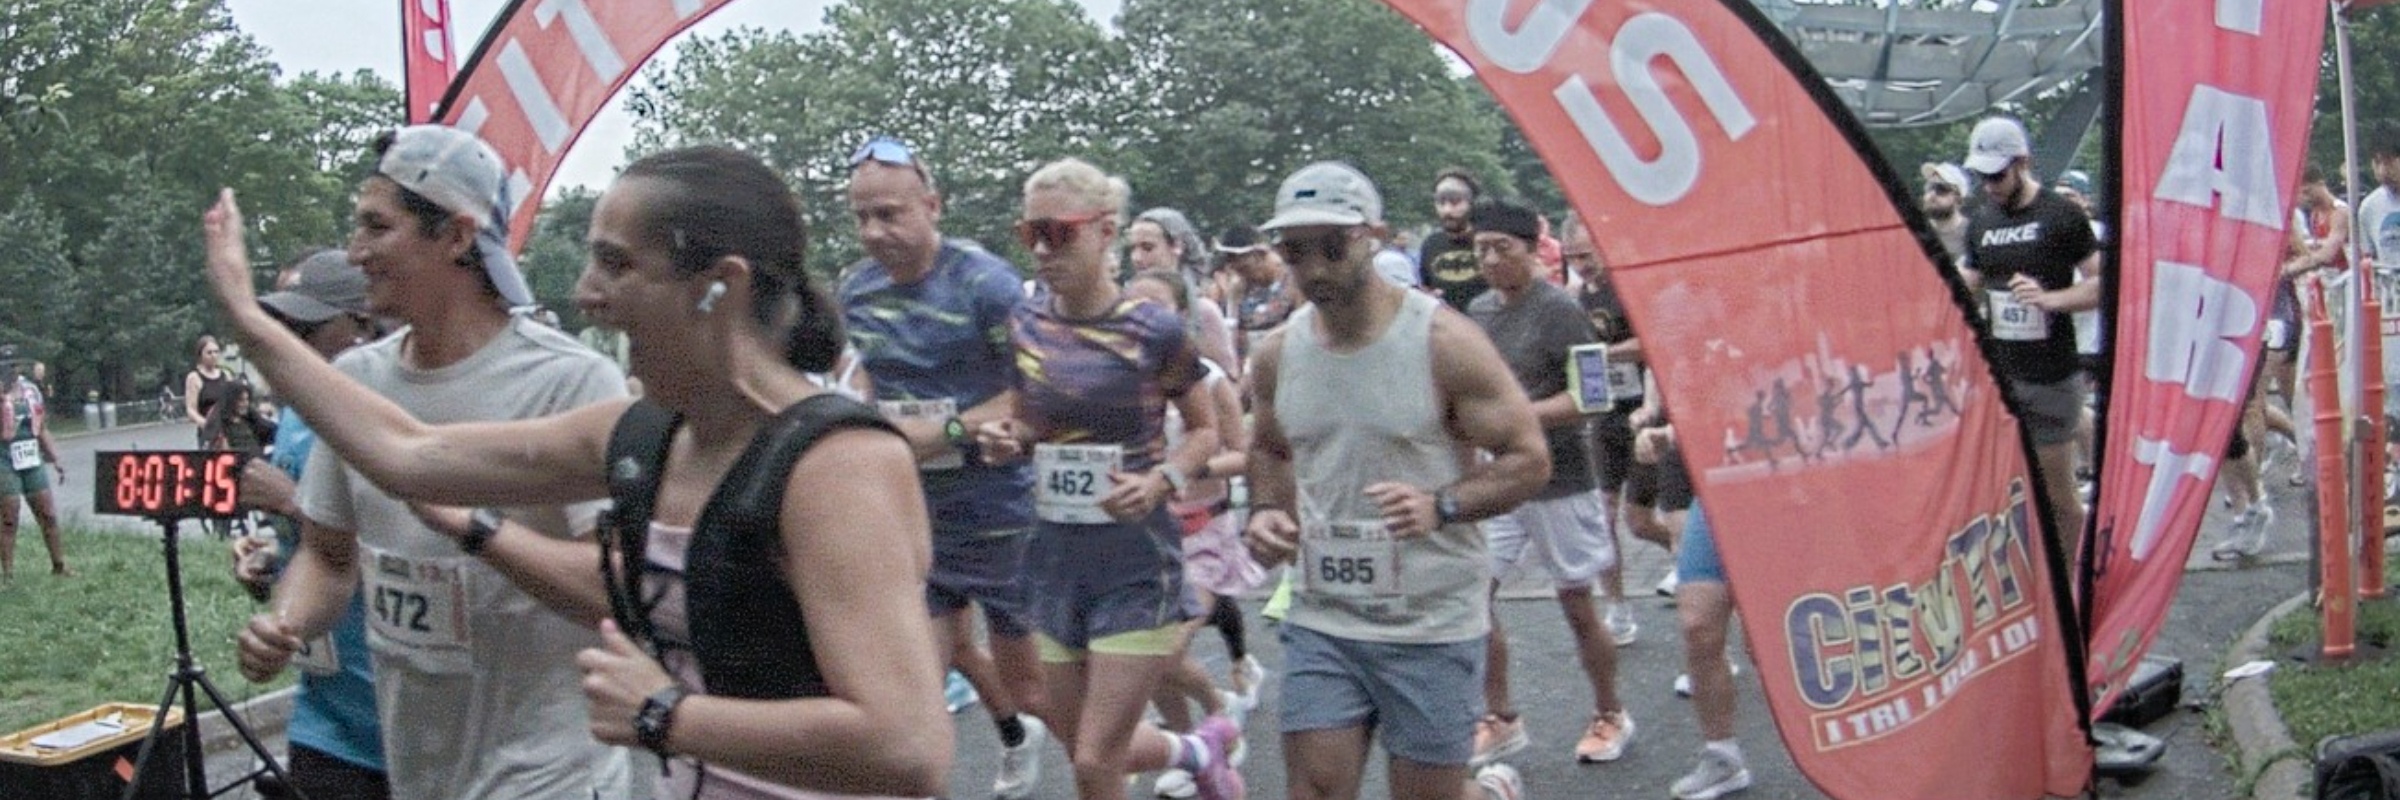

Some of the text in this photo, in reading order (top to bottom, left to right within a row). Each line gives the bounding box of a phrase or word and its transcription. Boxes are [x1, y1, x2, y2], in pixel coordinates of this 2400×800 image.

[1982, 222, 2039, 247] NIKE
[2128, 0, 2285, 562] ART
[117, 454, 237, 514] 8:07:15
[1047, 470, 1094, 496] 462
[1321, 556, 1375, 584] 685
[374, 586, 431, 632] 472
[1846, 696, 1911, 738] TRI
